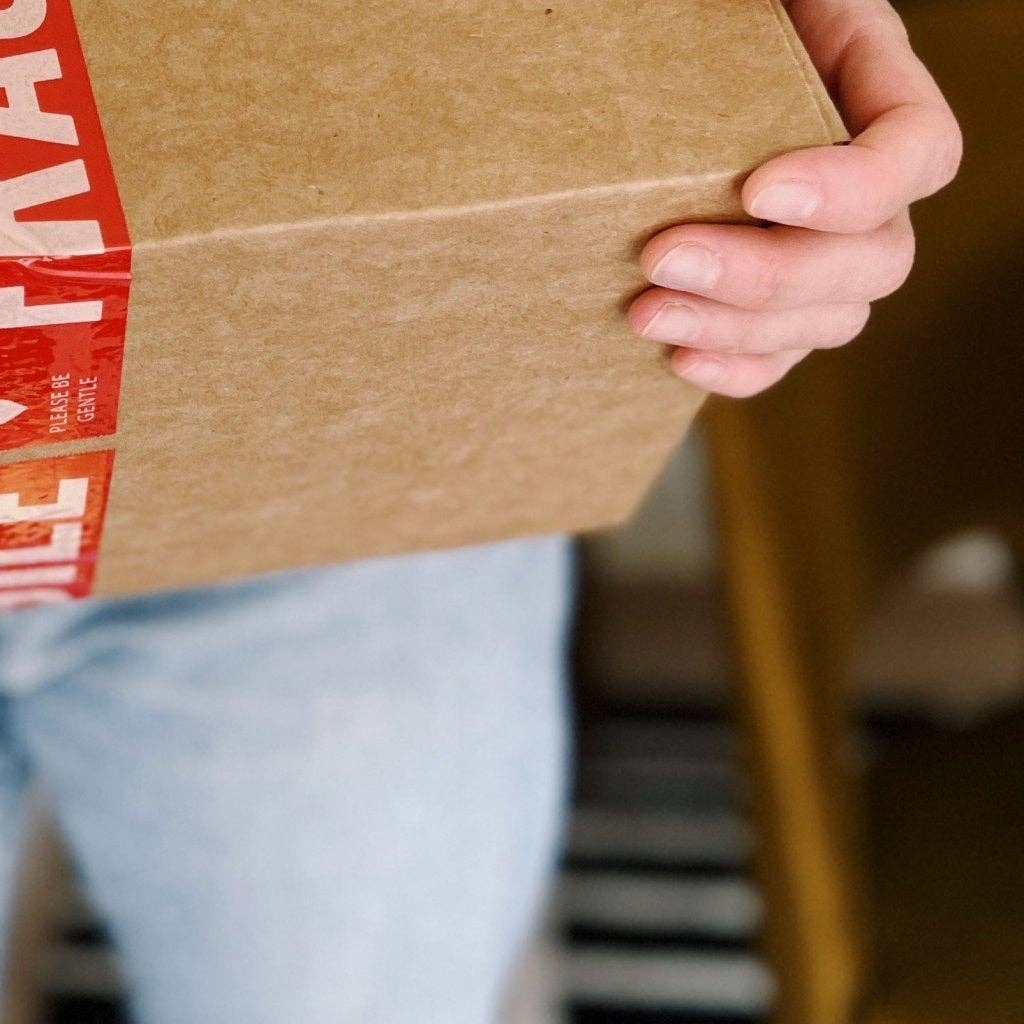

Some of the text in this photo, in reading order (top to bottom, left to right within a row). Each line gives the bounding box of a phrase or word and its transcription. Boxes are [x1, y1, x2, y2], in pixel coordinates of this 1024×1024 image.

[49, 372, 70, 434] PLEASE BE
[77, 376, 97, 423] GENTLE
